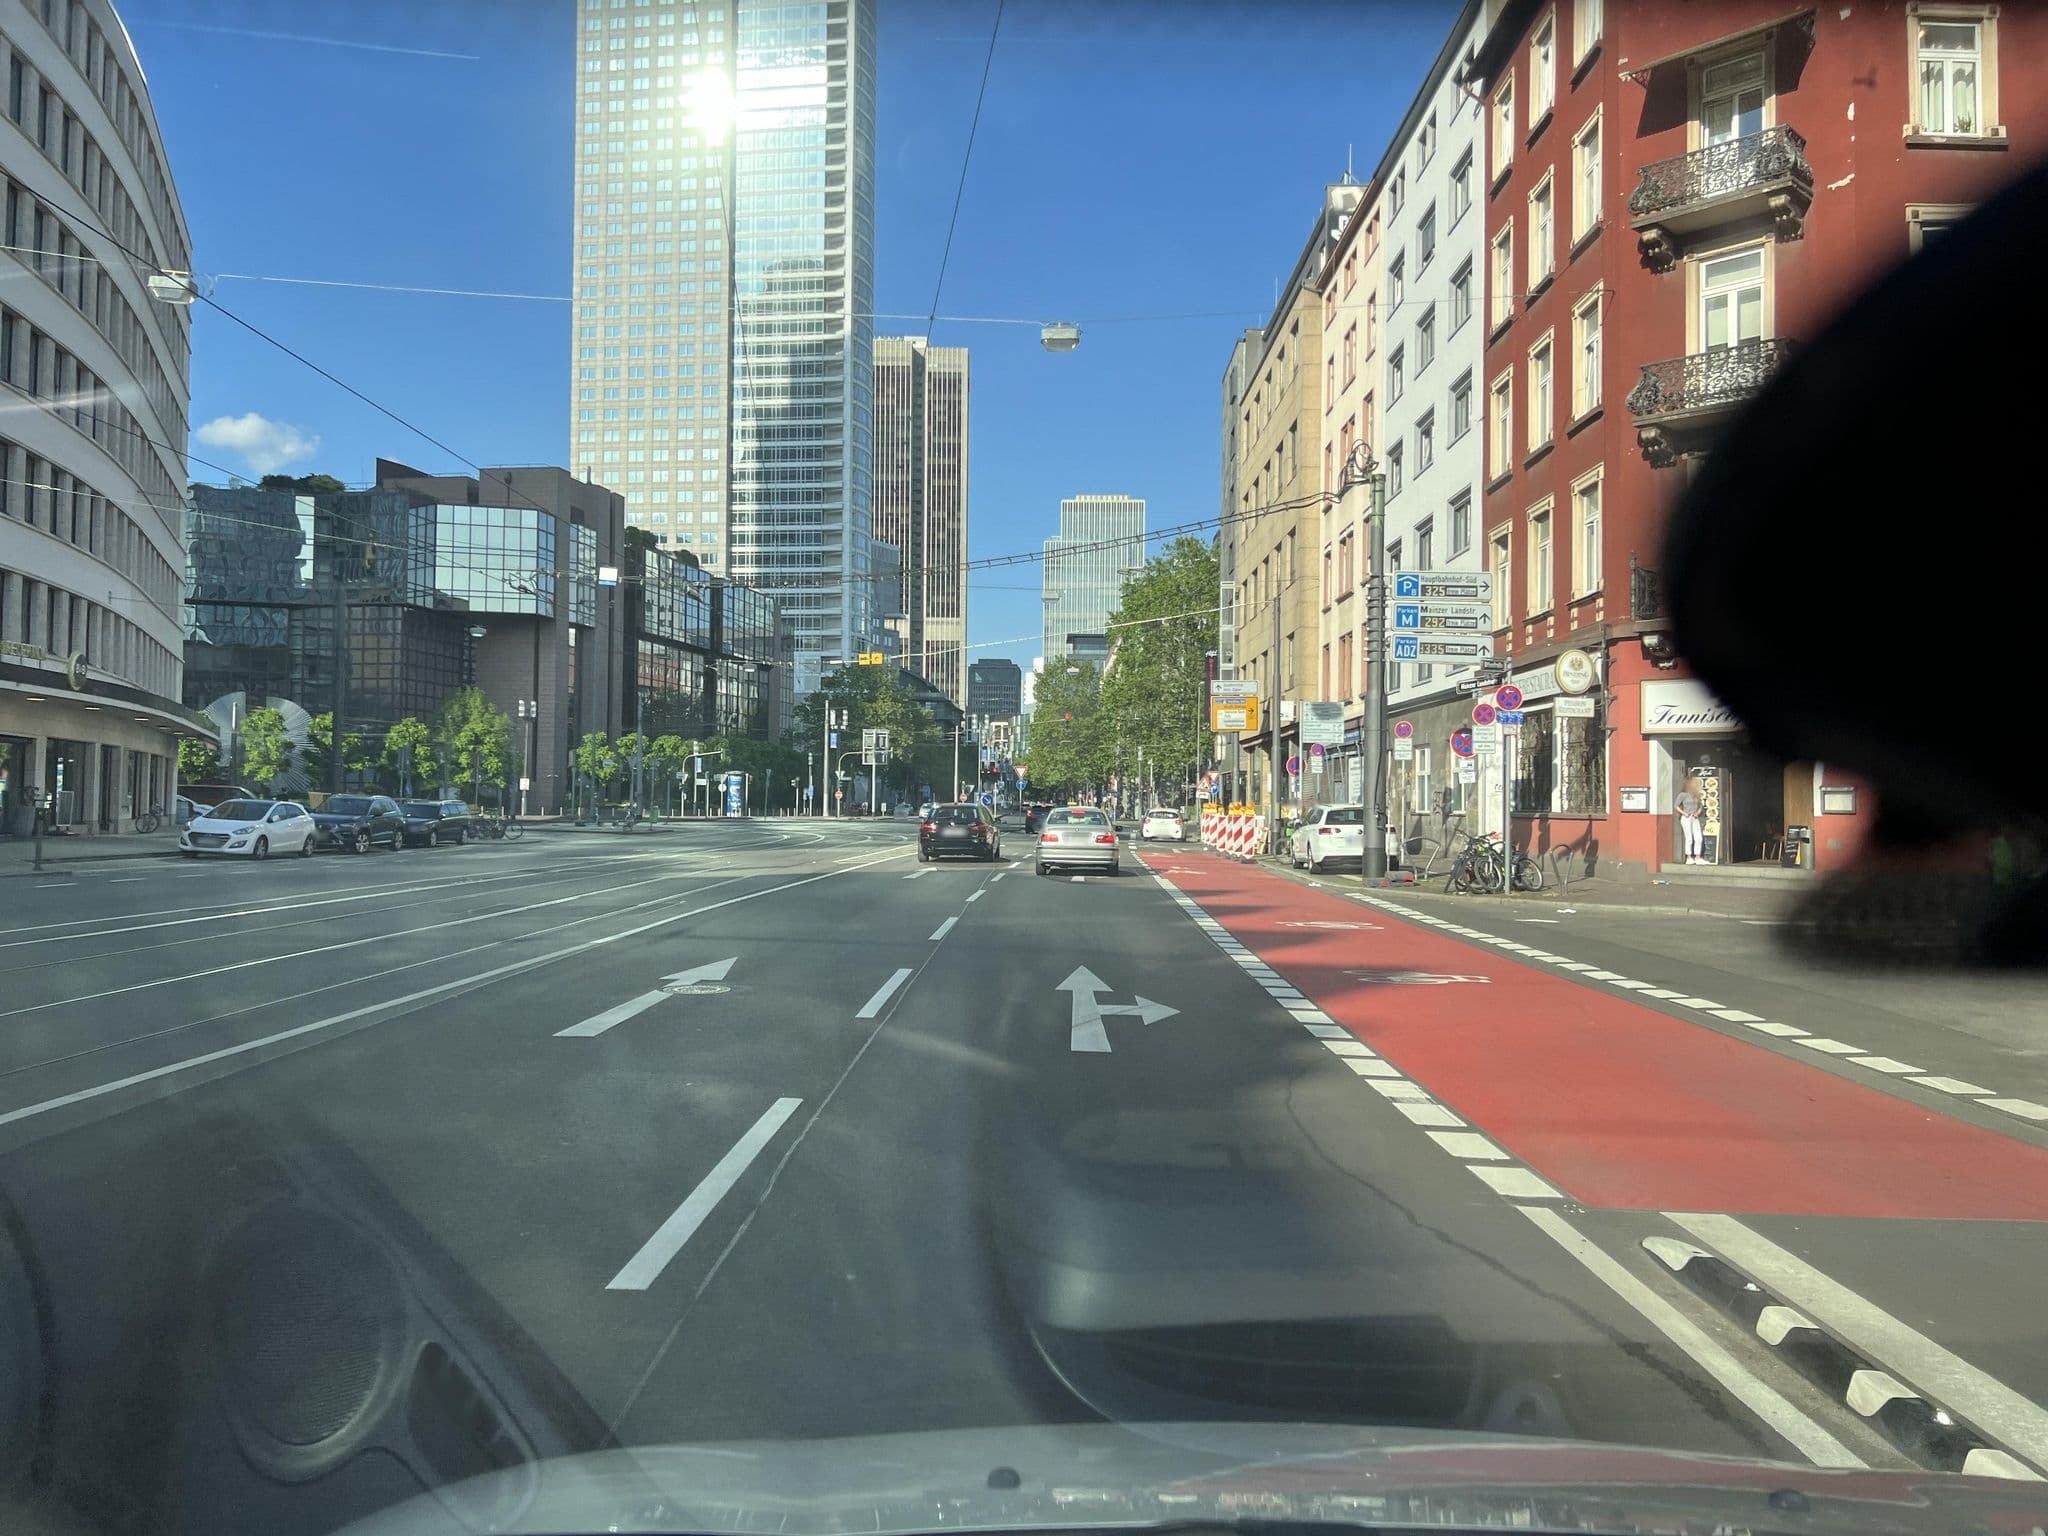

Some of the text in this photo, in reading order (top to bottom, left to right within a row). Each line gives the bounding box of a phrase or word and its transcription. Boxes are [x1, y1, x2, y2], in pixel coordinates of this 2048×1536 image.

[1420, 575, 1477, 584] Hauptbahnhof-Süd
[1403, 581, 1412, 592] P
[1425, 586, 1446, 596] 325
[1420, 606, 1448, 614] Mainzer
[1402, 614, 1413, 626] M
[1425, 617, 1446, 628] 292
[1396, 645, 1417, 657] ADZ
